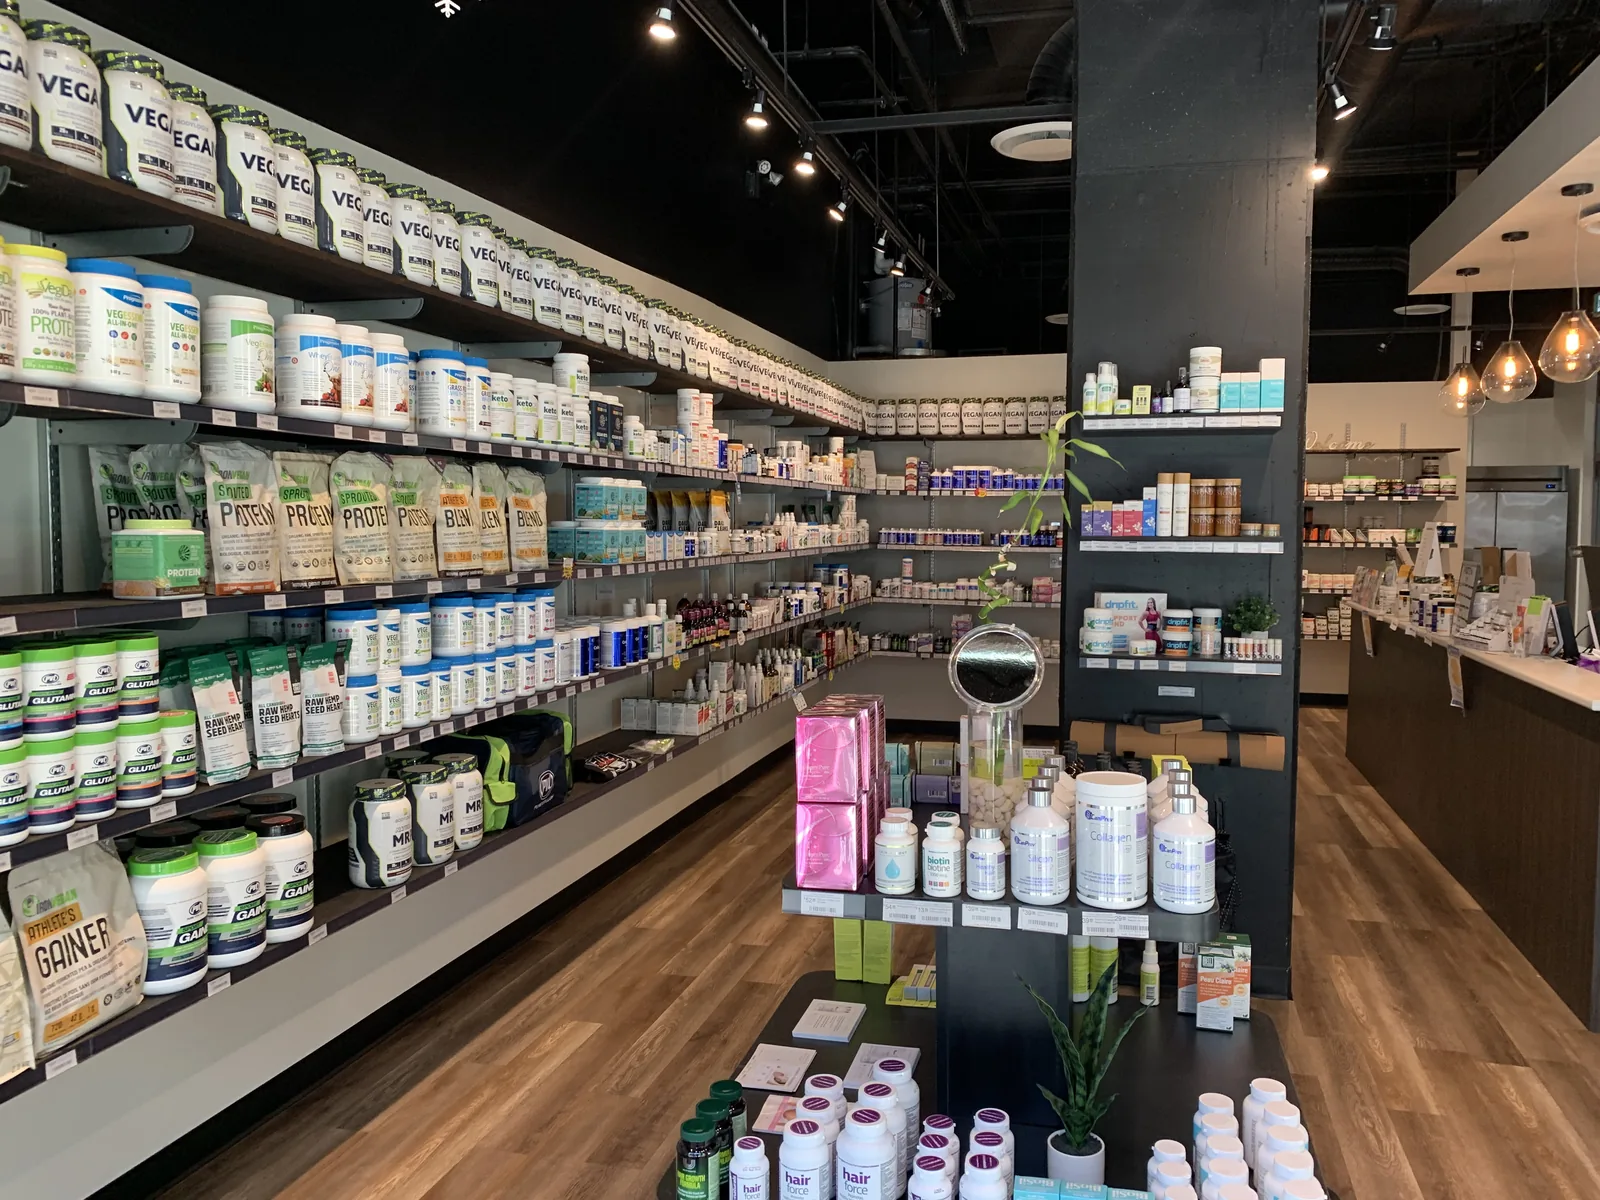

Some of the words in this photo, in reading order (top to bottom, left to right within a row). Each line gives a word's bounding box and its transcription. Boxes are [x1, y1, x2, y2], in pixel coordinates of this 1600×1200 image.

[37, 73, 99, 108] VEGA
[125, 103, 173, 135] VEG
[240, 152, 275, 176] VEG
[277, 173, 314, 196] VEG
[332, 190, 361, 212] VEG
[362, 208, 392, 227] VEG
[401, 221, 432, 240] VEG
[434, 235, 459, 251] VEG
[470, 246, 497, 263] VEG
[31, 315, 73, 337] PROTE
[492, 394, 508, 402] keto
[343, 506, 388, 529] PROTEI
[444, 509, 474, 528] BLEN
[167, 568, 201, 578] PROTEIN
[305, 698, 324, 707] RAW
[325, 695, 340, 704] HEMP
[259, 706, 279, 716] RAW
[280, 704, 294, 714] HEMP
[305, 706, 325, 714] SEED
[204, 718, 225, 729] RAW
[225, 713, 241, 725] HEMP
[260, 716, 280, 725] SEED
[281, 712, 300, 722] HEARTS
[206, 726, 227, 738] SEED
[228, 721, 244, 734] HEART
[466, 801, 482, 814] MR
[439, 813, 454, 825] MR
[393, 834, 411, 847] MR
[1090, 831, 1131, 843] Collagen
[927, 856, 950, 865] biotin
[927, 863, 951, 872] biotine
[1165, 860, 1200, 872] Collagen
[285, 881, 314, 898] GAINE
[28, 907, 76, 940] ATHLETE'S
[35, 917, 111, 978] GAINER
[1215, 976, 1232, 985] Claire
[786, 1171, 811, 1186] hair
[843, 1167, 870, 1184] hair
[743, 1184, 761, 1193] hair
[786, 1182, 809, 1196] force
[844, 1180, 868, 1196] force
